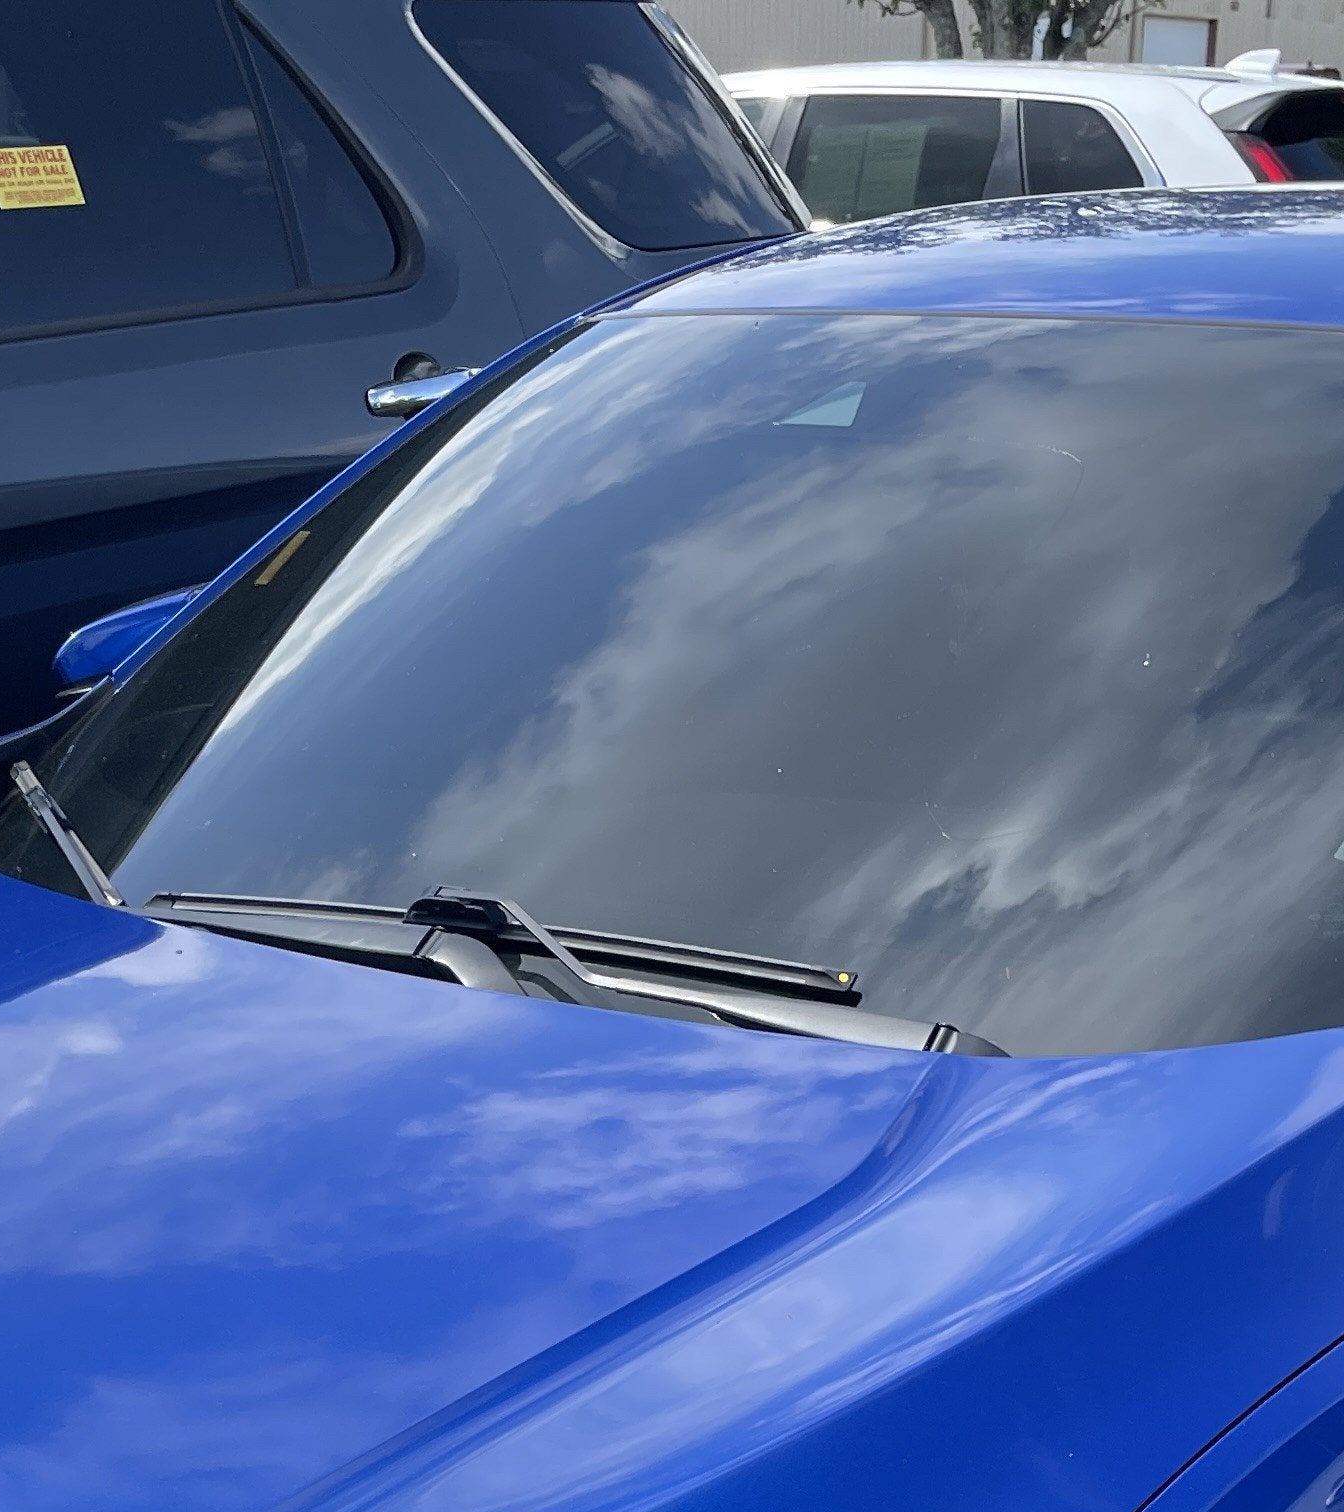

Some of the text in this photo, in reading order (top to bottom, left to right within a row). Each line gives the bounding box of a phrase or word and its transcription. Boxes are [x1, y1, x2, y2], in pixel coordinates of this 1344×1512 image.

[19, 149, 66, 164] VEHICLE
[20, 166, 41, 177] FOR
[43, 164, 68, 176] SALE
